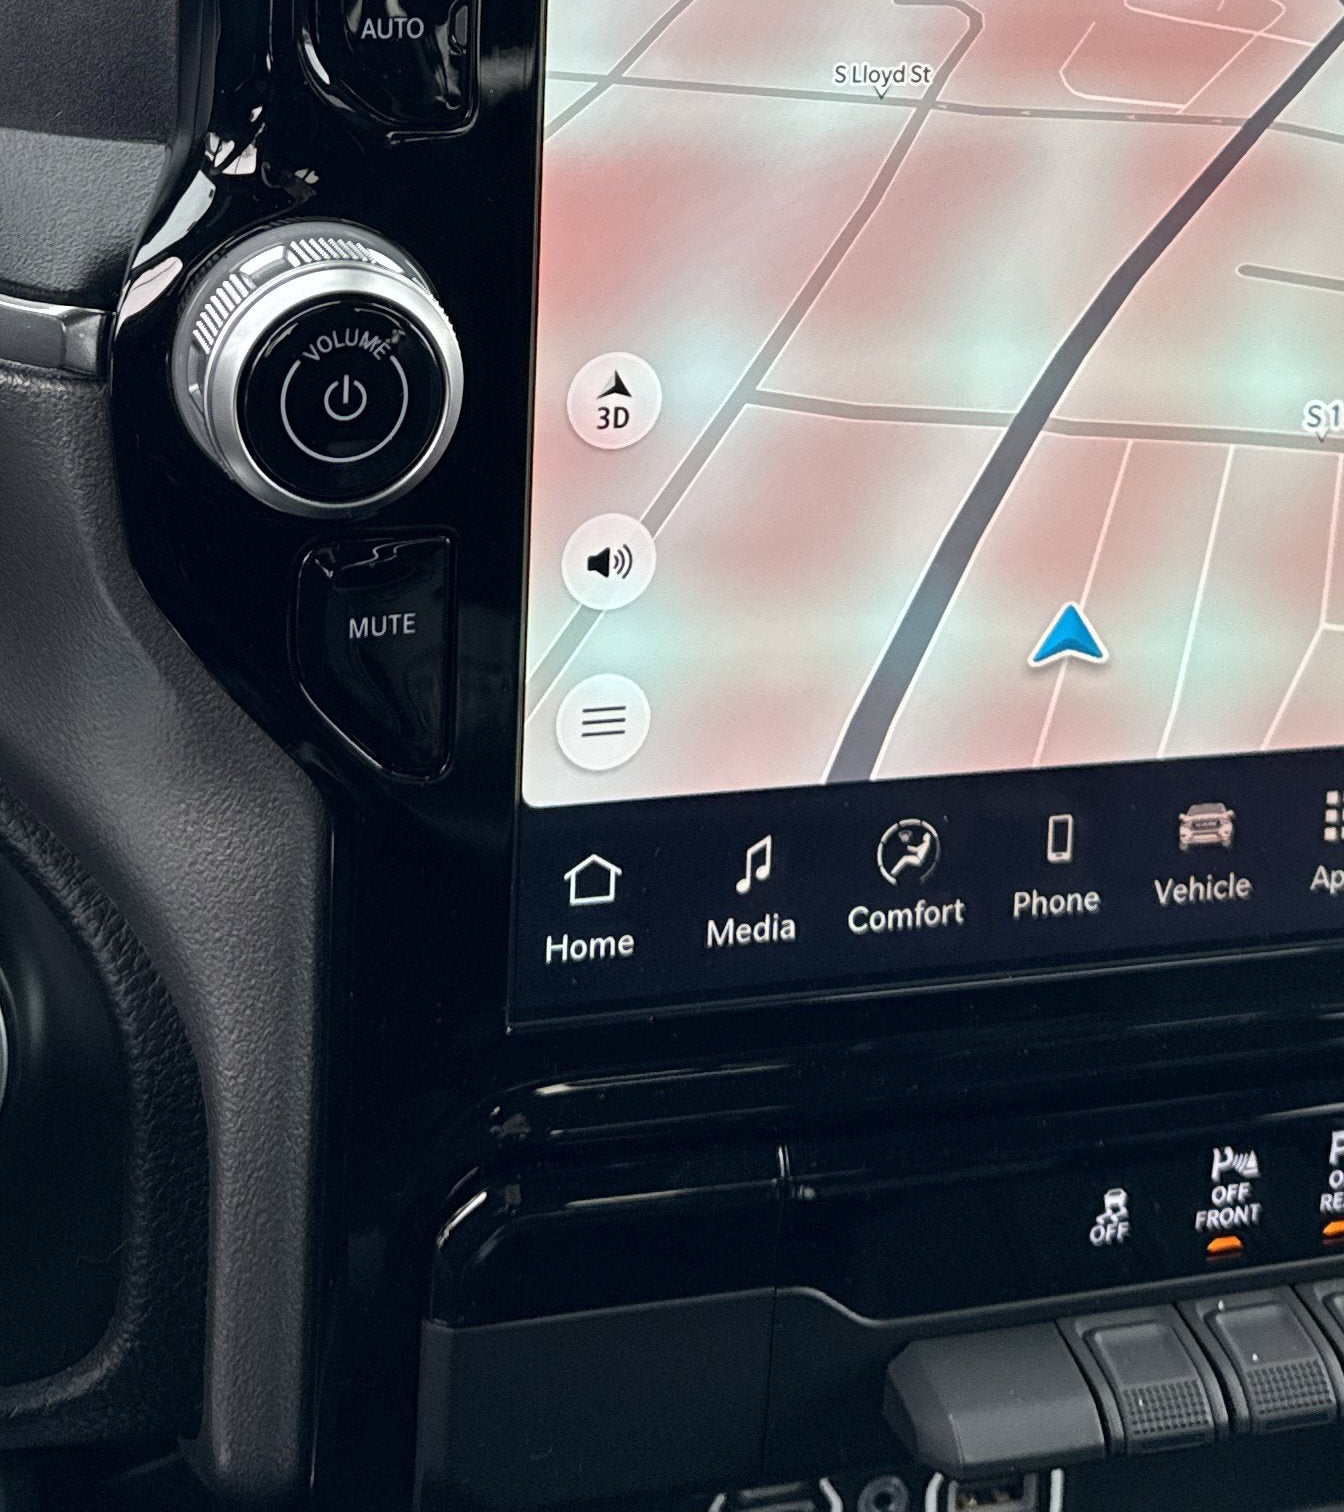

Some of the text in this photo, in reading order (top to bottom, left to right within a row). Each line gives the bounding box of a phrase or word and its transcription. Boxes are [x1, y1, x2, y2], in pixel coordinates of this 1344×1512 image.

[360, 16, 425, 40] AUTO
[834, 65, 931, 90] S Lloyd St
[302, 328, 392, 363] VOLUME
[596, 407, 630, 430] 3D
[1307, 405, 1322, 427] S
[349, 613, 417, 639] MUTE
[1155, 873, 1252, 906] Vehicle
[848, 898, 965, 935] Comfort
[1013, 889, 1100, 920] Phone
[706, 915, 796, 948] Media
[545, 931, 635, 964] Home
[1211, 1185, 1251, 1207] OFF
[1195, 1203, 1260, 1232] FRONT
[1090, 1222, 1130, 1247] OFF
